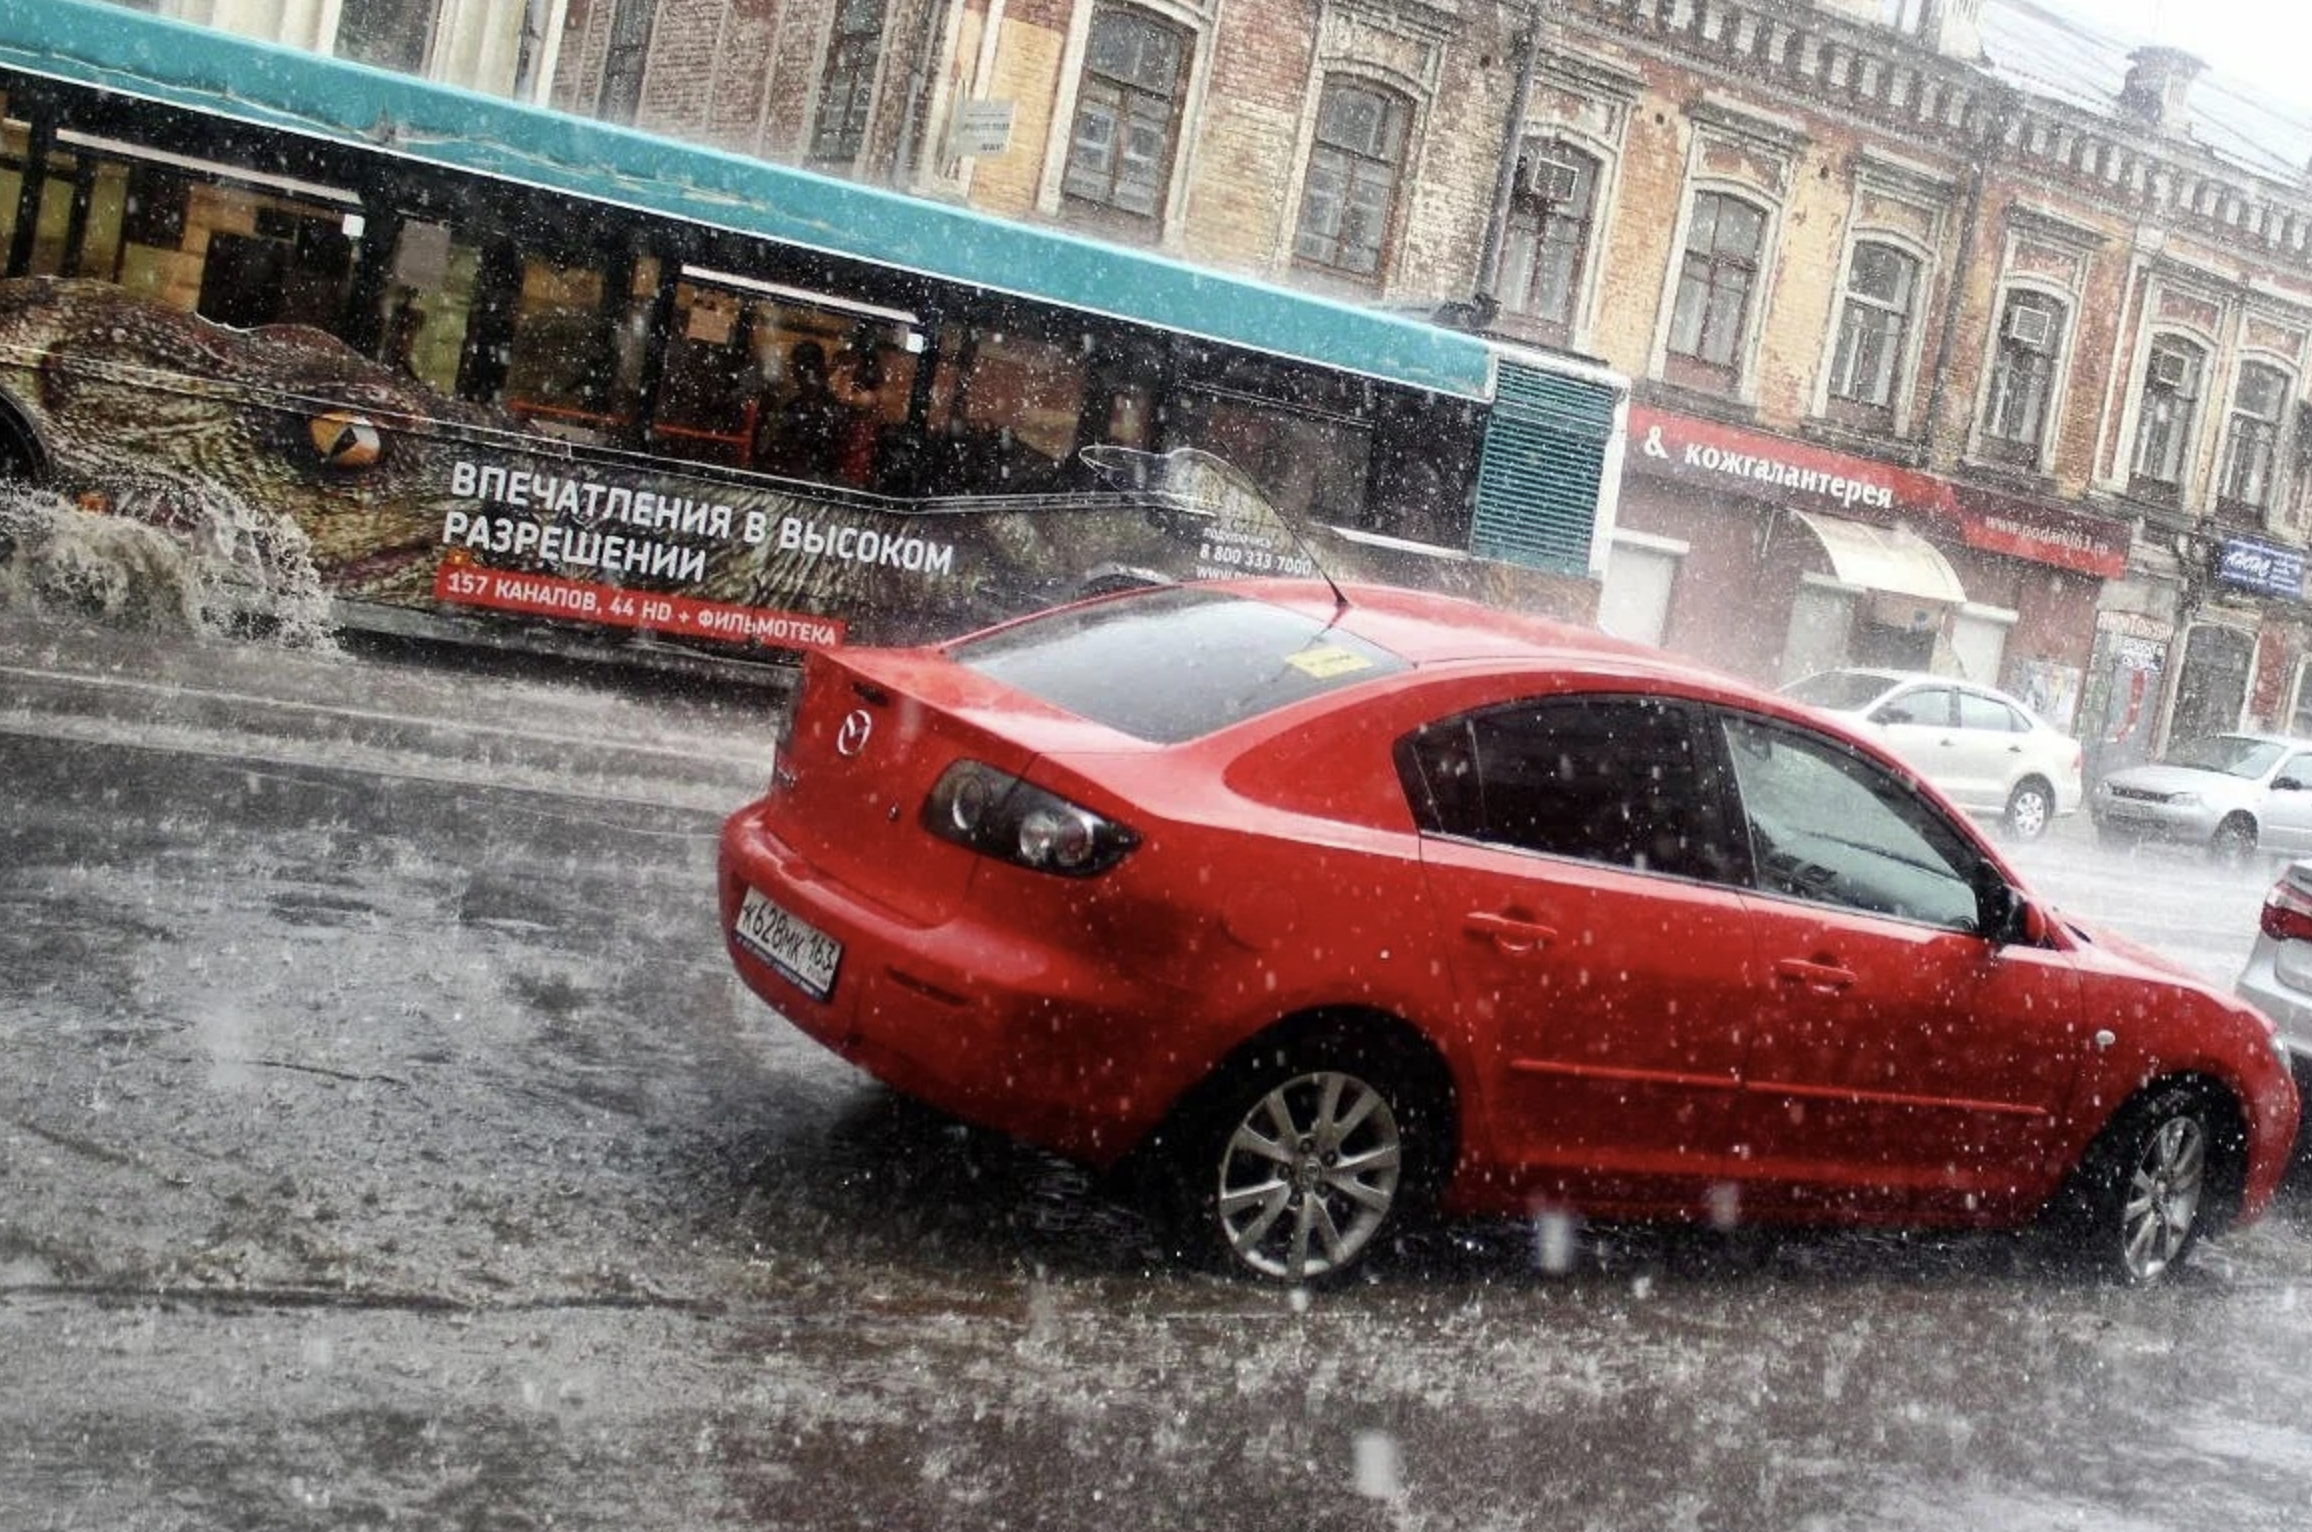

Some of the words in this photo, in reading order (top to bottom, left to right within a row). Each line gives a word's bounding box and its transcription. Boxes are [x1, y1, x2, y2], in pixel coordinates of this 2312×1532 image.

[1643, 425, 1669, 459] &
[1684, 442, 1894, 508] кожгалантерея
[442, 511, 706, 583] РАЗРЕШЕНИИ
[451, 461, 732, 539] ВПЕЧАТЛЕНИЯ
[743, 511, 767, 544] В
[779, 517, 954, 575] ВЫСОКОМ
[1200, 543, 1210, 560] 8
[1214, 545, 1242, 565] 800
[1244, 550, 1272, 569] 333
[1277, 555, 1312, 576] 7000
[446, 572, 489, 596] 157
[494, 578, 602, 615] КАНАЛОВ,
[608, 597, 636, 617] 44
[642, 602, 673, 622] HD
[678, 611, 690, 624] +
[697, 609, 837, 646] ФИЛЬМОТЕКА
[808, 934, 837, 972] 163
